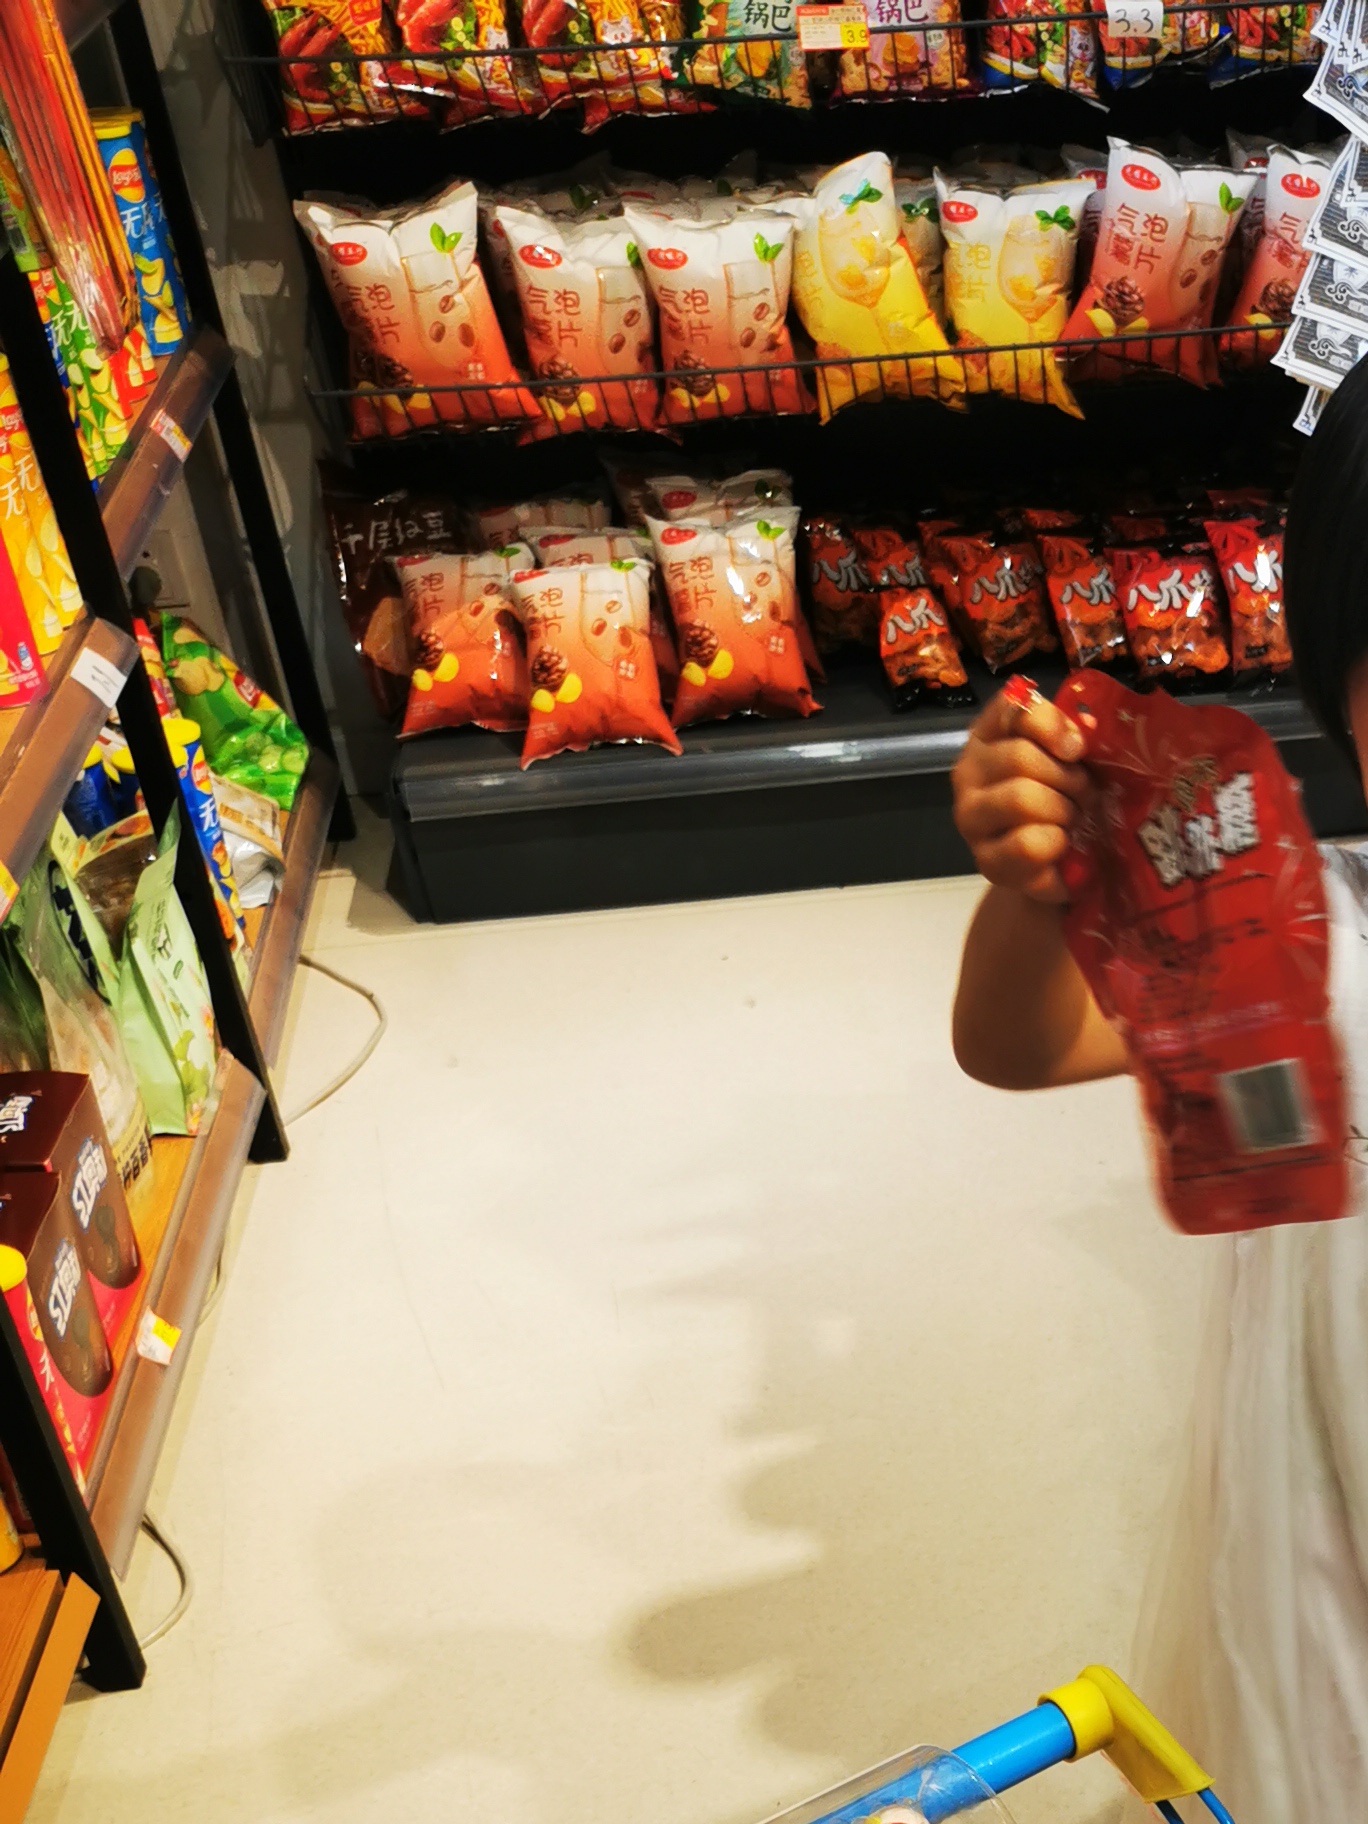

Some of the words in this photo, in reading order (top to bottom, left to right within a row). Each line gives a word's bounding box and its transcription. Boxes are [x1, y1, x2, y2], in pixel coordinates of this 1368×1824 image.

[744, 0, 792, 32] 锅巴
[876, 0, 929, 24] 锅巴
[1113, 9, 1155, 34] 3.3
[846, 29, 868, 44] 3.9
